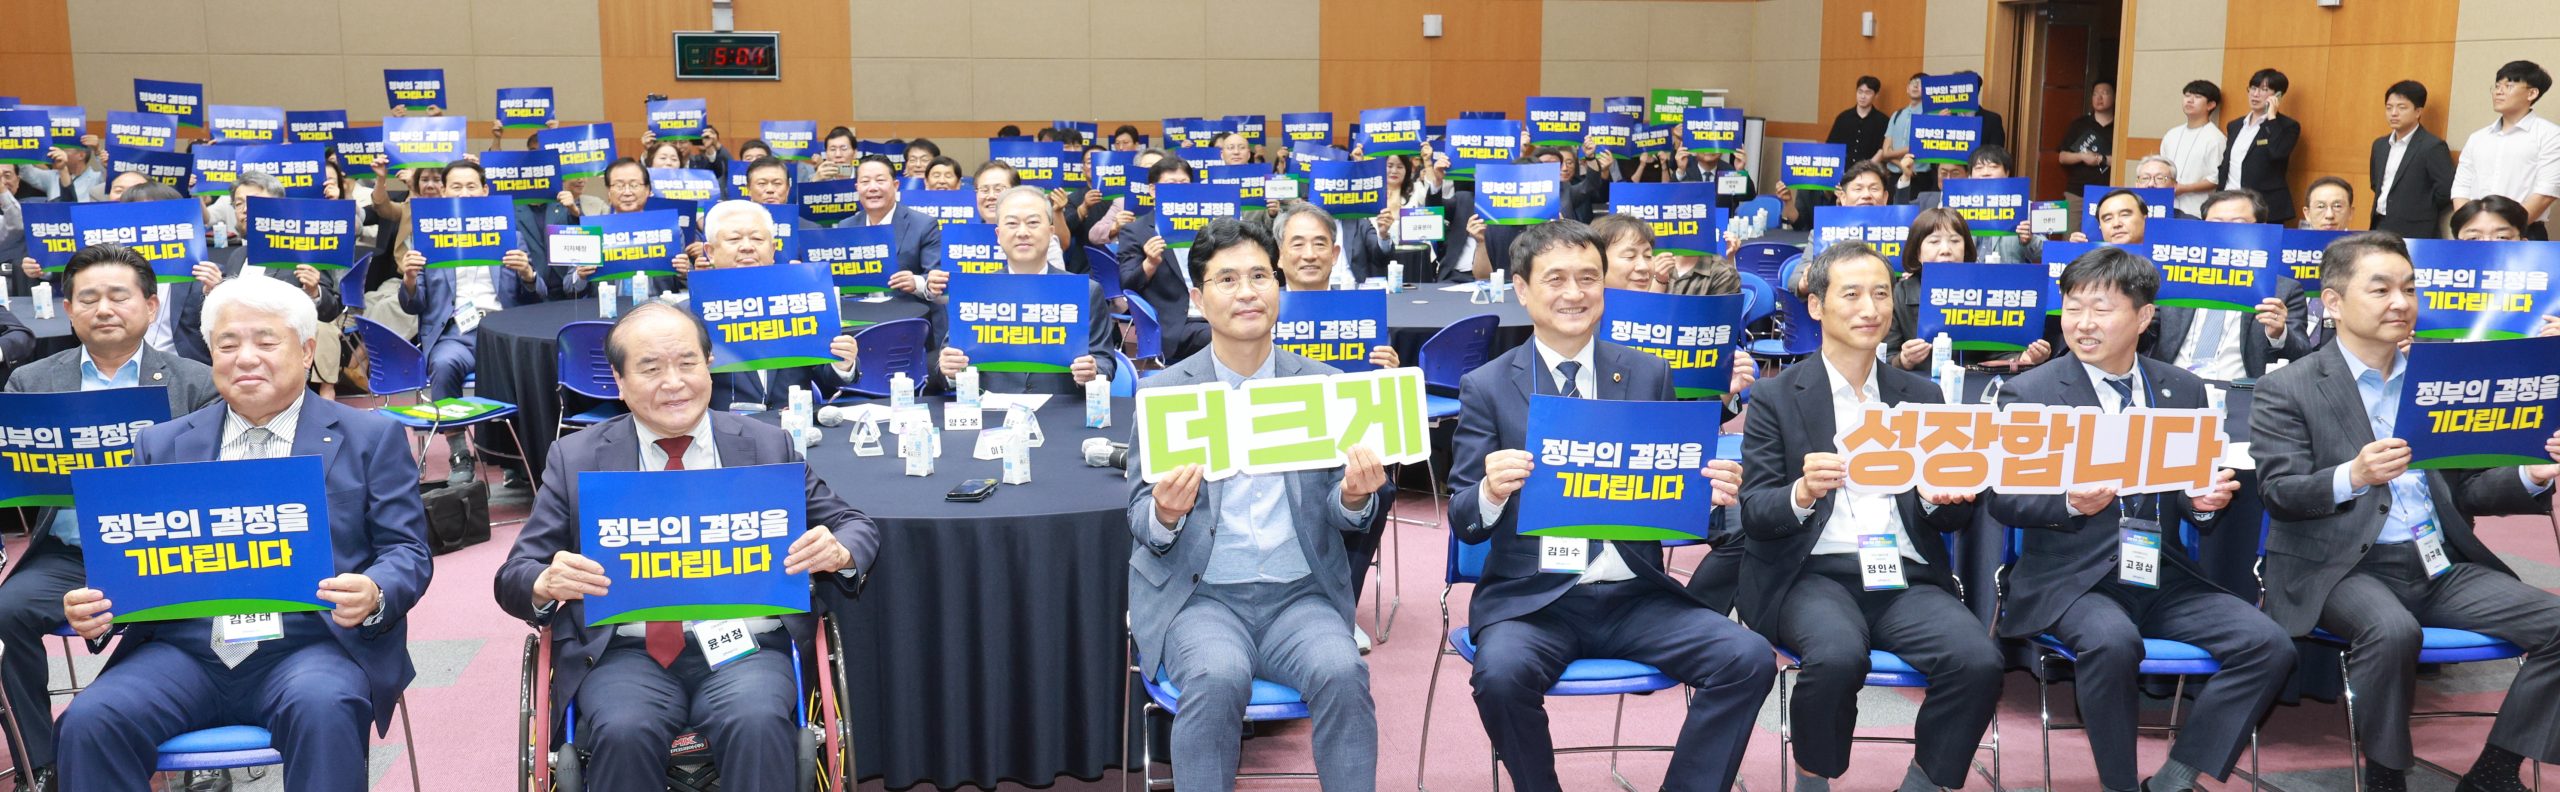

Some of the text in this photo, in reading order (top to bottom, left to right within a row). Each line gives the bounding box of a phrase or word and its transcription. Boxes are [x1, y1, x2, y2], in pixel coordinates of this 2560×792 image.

[1531, 111, 1586, 122] 정부의 결정을
[1365, 120, 1420, 132] 정부의 결정을
[1536, 122, 1580, 132] 기다립니다
[1915, 128, 1975, 140] 정부의 결정을
[1370, 132, 1416, 142] 기다립니다
[1451, 135, 1481, 146] 정부의
[1484, 136, 1515, 147] 결정을
[1457, 147, 1508, 159] 기다립니다
[1920, 140, 1968, 151] 기다립니다
[1786, 156, 1839, 167] 정부의 결정을
[486, 164, 555, 179] 정부의 결정을
[1791, 166, 1832, 177] 기다립니다
[493, 179, 550, 190] 기다립니다
[1314, 176, 1383, 190] 정부의 결정을
[1482, 180, 1553, 193] 정부의 결정을
[1320, 191, 1378, 204] 기다립니다
[1489, 194, 1546, 207] 기다립니다
[1949, 194, 2022, 206] 정부의 결정을
[1162, 202, 1234, 216] 정부의 결정을
[1662, 204, 1706, 219] 결정을
[1958, 208, 2015, 220] 기다립니다
[255, 218, 347, 234] 정부의 결정을
[420, 216, 508, 232] 정부의 결정을
[141, 224, 194, 242] 결정을
[430, 232, 500, 248] 기다립니다
[633, 229, 672, 244] 결정을
[265, 234, 338, 250] 기다립니다
[808, 244, 888, 261] 정부의 결정을
[948, 244, 990, 259] 정부의
[2152, 244, 2268, 268] 정부의 결정을
[2162, 265, 2254, 287] 기다립니다
[2414, 268, 2548, 290] 정부의 결정을
[1930, 288, 2038, 307] 정부의 결정을
[2424, 292, 2532, 312] 기다립니다
[702, 292, 826, 320] 정부의 결정을
[960, 302, 1078, 323] 정부의 결정을
[1941, 309, 2025, 326] 기다립니다
[718, 316, 818, 342] 기다립니다
[972, 326, 1066, 344] 기다립니다
[1320, 320, 1376, 340] 결정을
[1612, 320, 1731, 346] 정부의 결정을
[2416, 375, 2560, 407] 정부의 결정을
[1146, 375, 1422, 474] 더 크게
[2428, 406, 2543, 432] 기다립니다
[0, 425, 62, 449] 부의
[1541, 438, 1702, 470] 정부의 결정을
[1840, 409, 2223, 489] 성장합니다
[1556, 472, 1684, 500] 기다립니다
[98, 503, 308, 544] 정부의 결정을
[598, 509, 788, 547] 정부의 결정을
[124, 539, 292, 576] 기다립니다
[1548, 546, 1580, 556] 김희수
[620, 545, 771, 578] 기다립니다
[1867, 564, 1896, 574] 정인선
[2126, 560, 2152, 572] 고정삼
[708, 628, 742, 650] 윤석정
